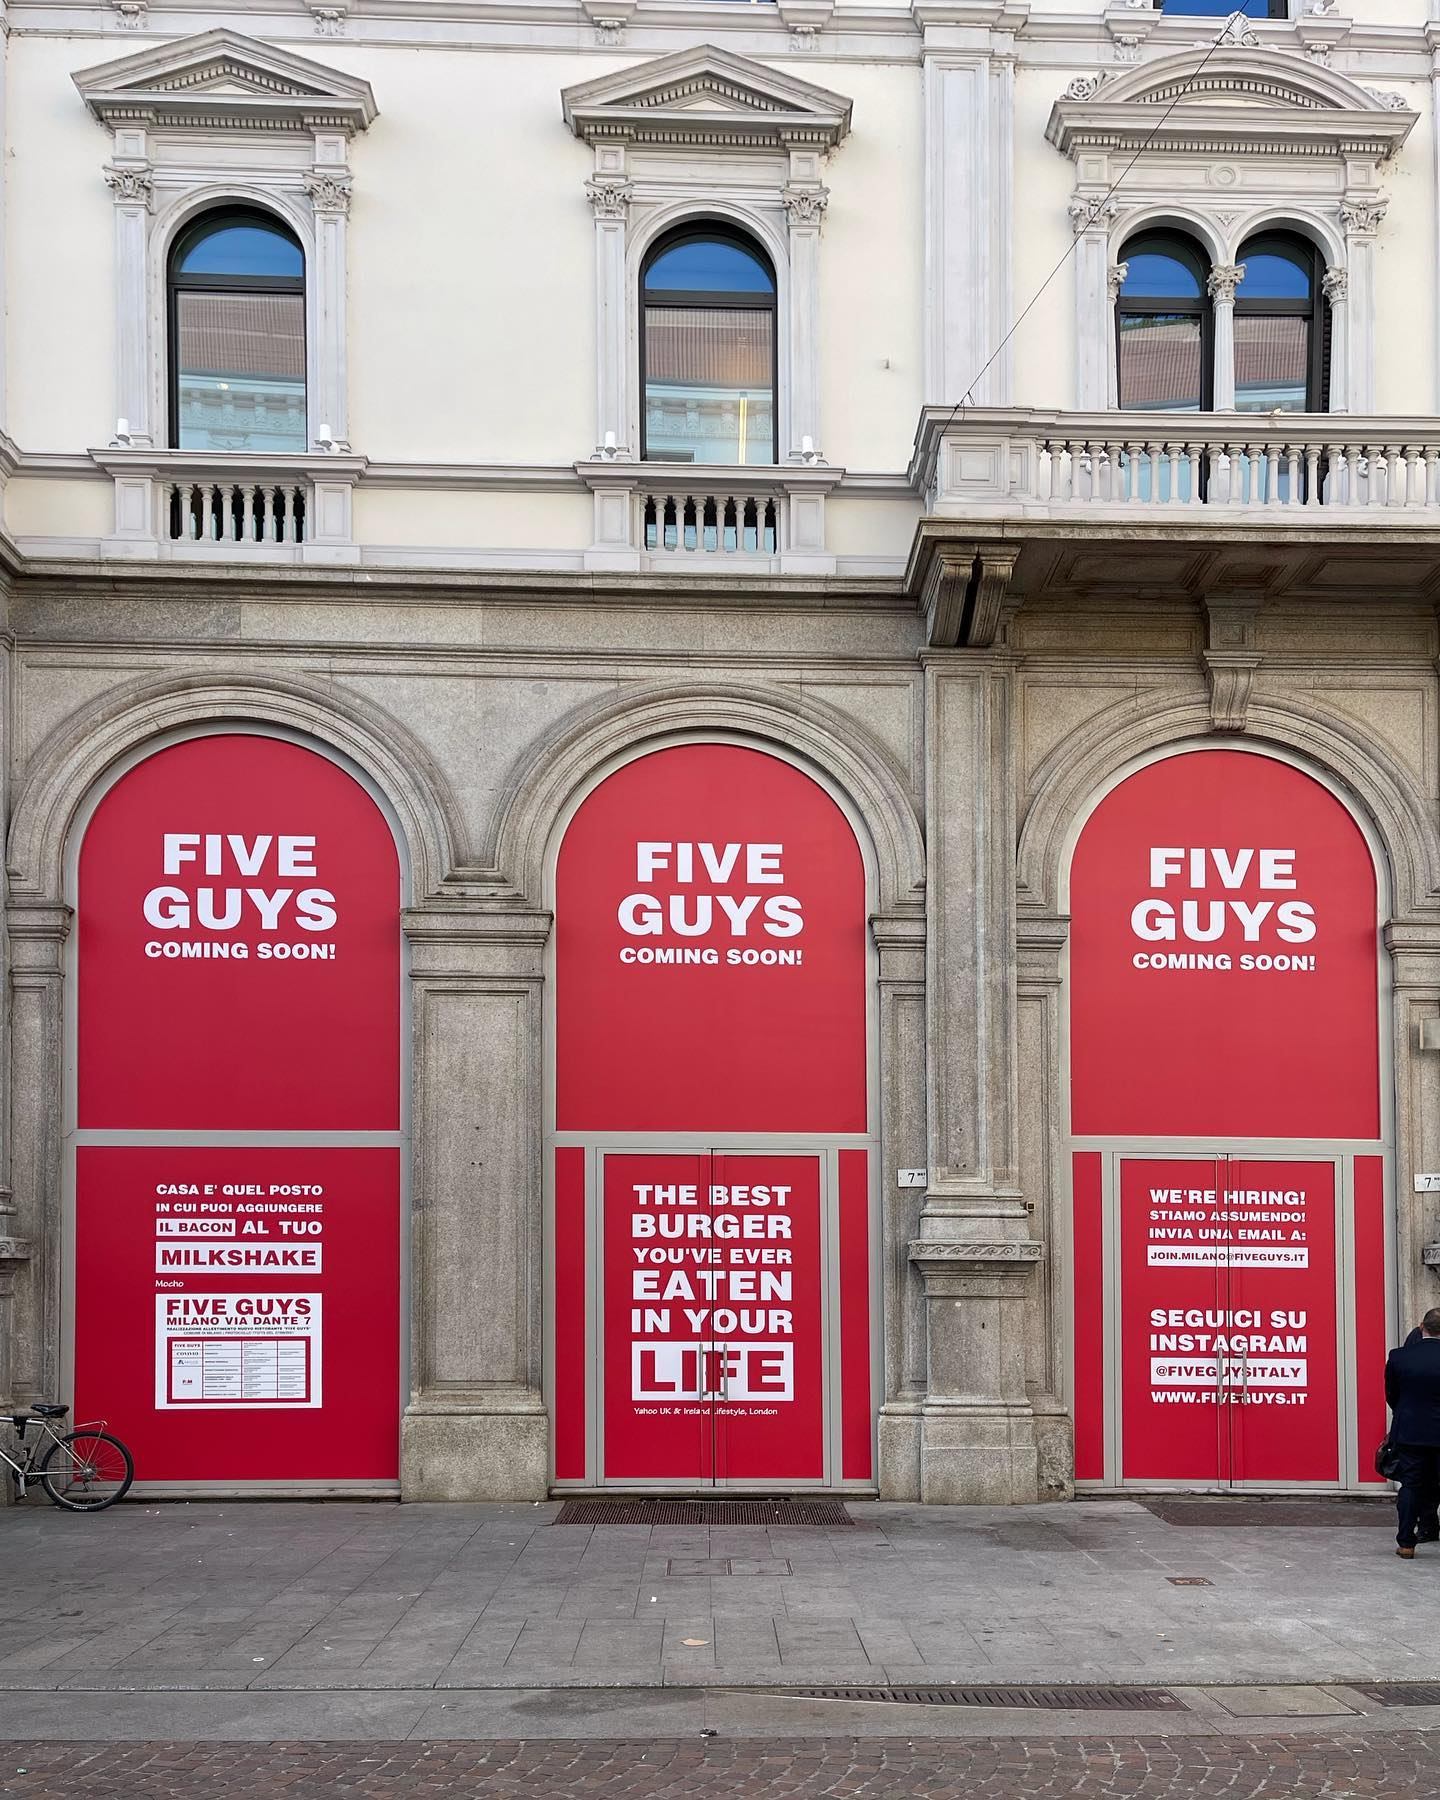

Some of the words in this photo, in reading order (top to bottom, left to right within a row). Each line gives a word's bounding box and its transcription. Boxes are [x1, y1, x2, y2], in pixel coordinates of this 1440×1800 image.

[164, 834, 316, 876] FIVE
[637, 842, 783, 883] FIVE
[1151, 848, 1296, 889] FIVE
[144, 887, 337, 931] GUYS
[618, 894, 803, 937] GUYS
[1131, 899, 1316, 943] GUYS
[144, 941, 249, 959] COMING
[256, 942, 336, 960] SOON!
[619, 947, 719, 965] COMING
[726, 948, 803, 966] SOON!
[1132, 952, 1232, 970] COMING
[1239, 954, 1316, 971] SOON!
[907, 1172, 915, 1184] 7
[1424, 1177, 1432, 1188] 7
[156, 1184, 200, 1195] CASA
[204, 1184, 218, 1195] E'
[222, 1184, 266, 1196] QUEL
[269, 1184, 323, 1196] POSTO
[632, 1184, 698, 1206] THE
[708, 1184, 792, 1207] BEST
[1149, 1189, 1217, 1204] WE'RE
[1223, 1190, 1306, 1206] HIRING!
[155, 1203, 170, 1212] IN
[173, 1203, 197, 1213] CUI
[200, 1203, 233, 1213] PUOI
[235, 1203, 323, 1213] AGGIUNGERE
[1149, 1210, 1206, 1221] STIAMO
[1209, 1211, 1306, 1223] ASSUMENDO!
[159, 1222, 174, 1233] IL
[178, 1222, 233, 1233] BACON
[241, 1220, 270, 1234] AL
[278, 1220, 323, 1235] TUO
[632, 1213, 793, 1239] BURGER
[1149, 1227, 1194, 1240] INVIA
[1198, 1228, 1234, 1240] UNA
[1238, 1228, 1287, 1241] EMAIL
[1290, 1229, 1306, 1241] A:
[161, 1249, 316, 1267] MILKSHAKE
[632, 1247, 722, 1264] YOU'VE
[729, 1248, 793, 1265] EVER
[1150, 1251, 1305, 1262] JOIN.MILANO@FIVEGUYS.IT
[633, 1270, 792, 1300] EATEN
[166, 1298, 227, 1316] FIVE
[235, 1298, 311, 1316] GUYS
[166, 1316, 220, 1326] MILANO
[224, 1316, 248, 1326] VIA
[253, 1316, 299, 1325] DANTE
[303, 1316, 311, 1325] 7
[631, 1308, 670, 1333] IN
[683, 1308, 793, 1334] YOUR
[1150, 1308, 1261, 1328] SEGUICI
[1270, 1310, 1307, 1329] SU
[1150, 1334, 1307, 1354] INSTAGRAM
[640, 1350, 785, 1392] LIFE
[633, 1407, 658, 1415] Yahoo
[659, 1407, 672, 1415] UK
[673, 1407, 682, 1415] &
[683, 1407, 711, 1415] Ireland
[749, 1407, 778, 1415] London
